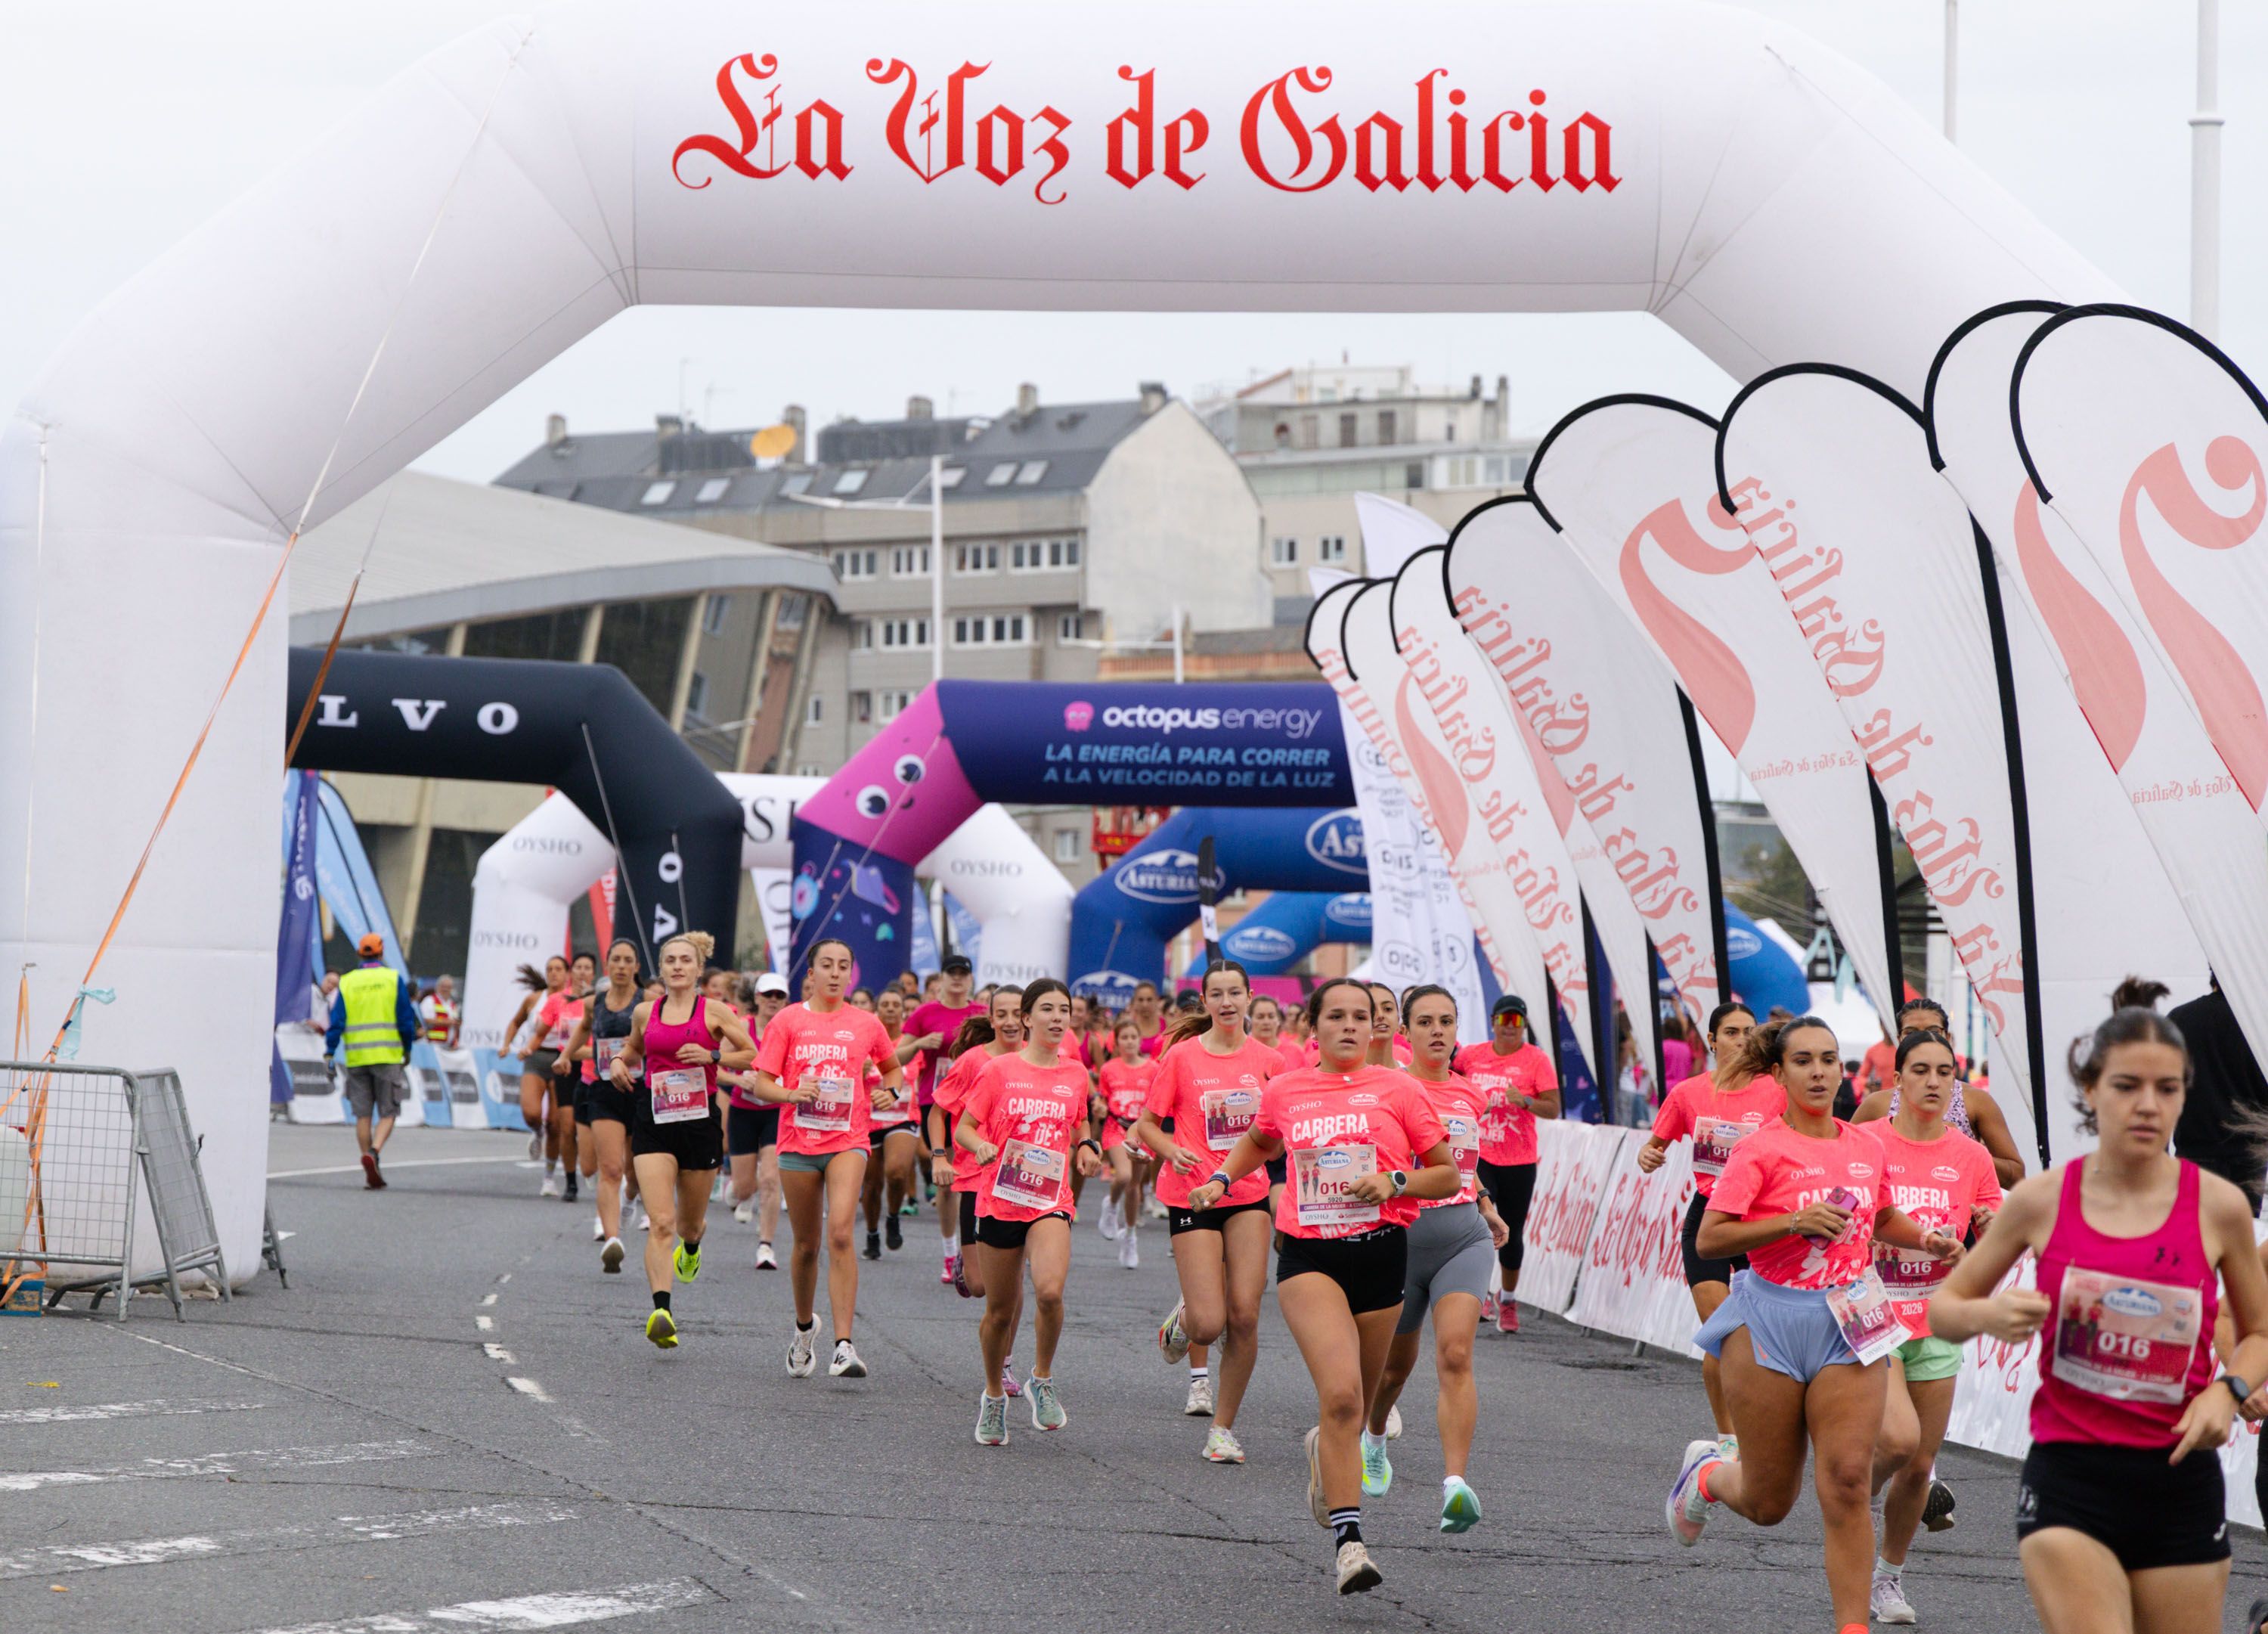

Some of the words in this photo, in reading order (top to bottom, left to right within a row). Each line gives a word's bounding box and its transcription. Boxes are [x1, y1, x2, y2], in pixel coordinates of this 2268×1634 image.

[672, 52, 854, 189] La
[866, 57, 1072, 205] Voz
[1105, 64, 1209, 191] de
[1240, 66, 1622, 194] Galicia
[318, 695, 519, 735] LVO
[1045, 744, 1072, 763] LA
[1078, 742, 1173, 764] ENERGÍA
[1176, 748, 1237, 766] PARA
[1241, 748, 1331, 767] CORRER
[1043, 767, 1059, 783] A
[1064, 768, 1091, 784] LA
[1098, 769, 1221, 786] VELOCIDAD
[1225, 770, 1256, 787] DE
[1259, 770, 1287, 787] LA
[1292, 771, 1337, 788] LUZ
[513, 836, 582, 856] OYSHO
[950, 859, 1023, 879] OYSHO
[475, 930, 538, 950] OYSHO
[795, 1044, 847, 1062] CARRERA
[1193, 1077, 1220, 1087] OYSHO
[668, 1093, 690, 1103] 016
[815, 1101, 837, 1112] 016
[1289, 1100, 1322, 1114] OYSHO
[1008, 1097, 1067, 1121] CARRERA
[1227, 1115, 1251, 1127] 016
[1291, 1113, 1371, 1143] CARRERA
[1019, 1171, 1044, 1186] 016
[1790, 1167, 1825, 1180] OYSHO
[1320, 1181, 1349, 1195] 016
[1901, 1261, 1932, 1274] 016
[1862, 1307, 1885, 1329] 016
[1901, 1302, 1923, 1316] 2026
[2098, 1331, 2151, 1359] 016
